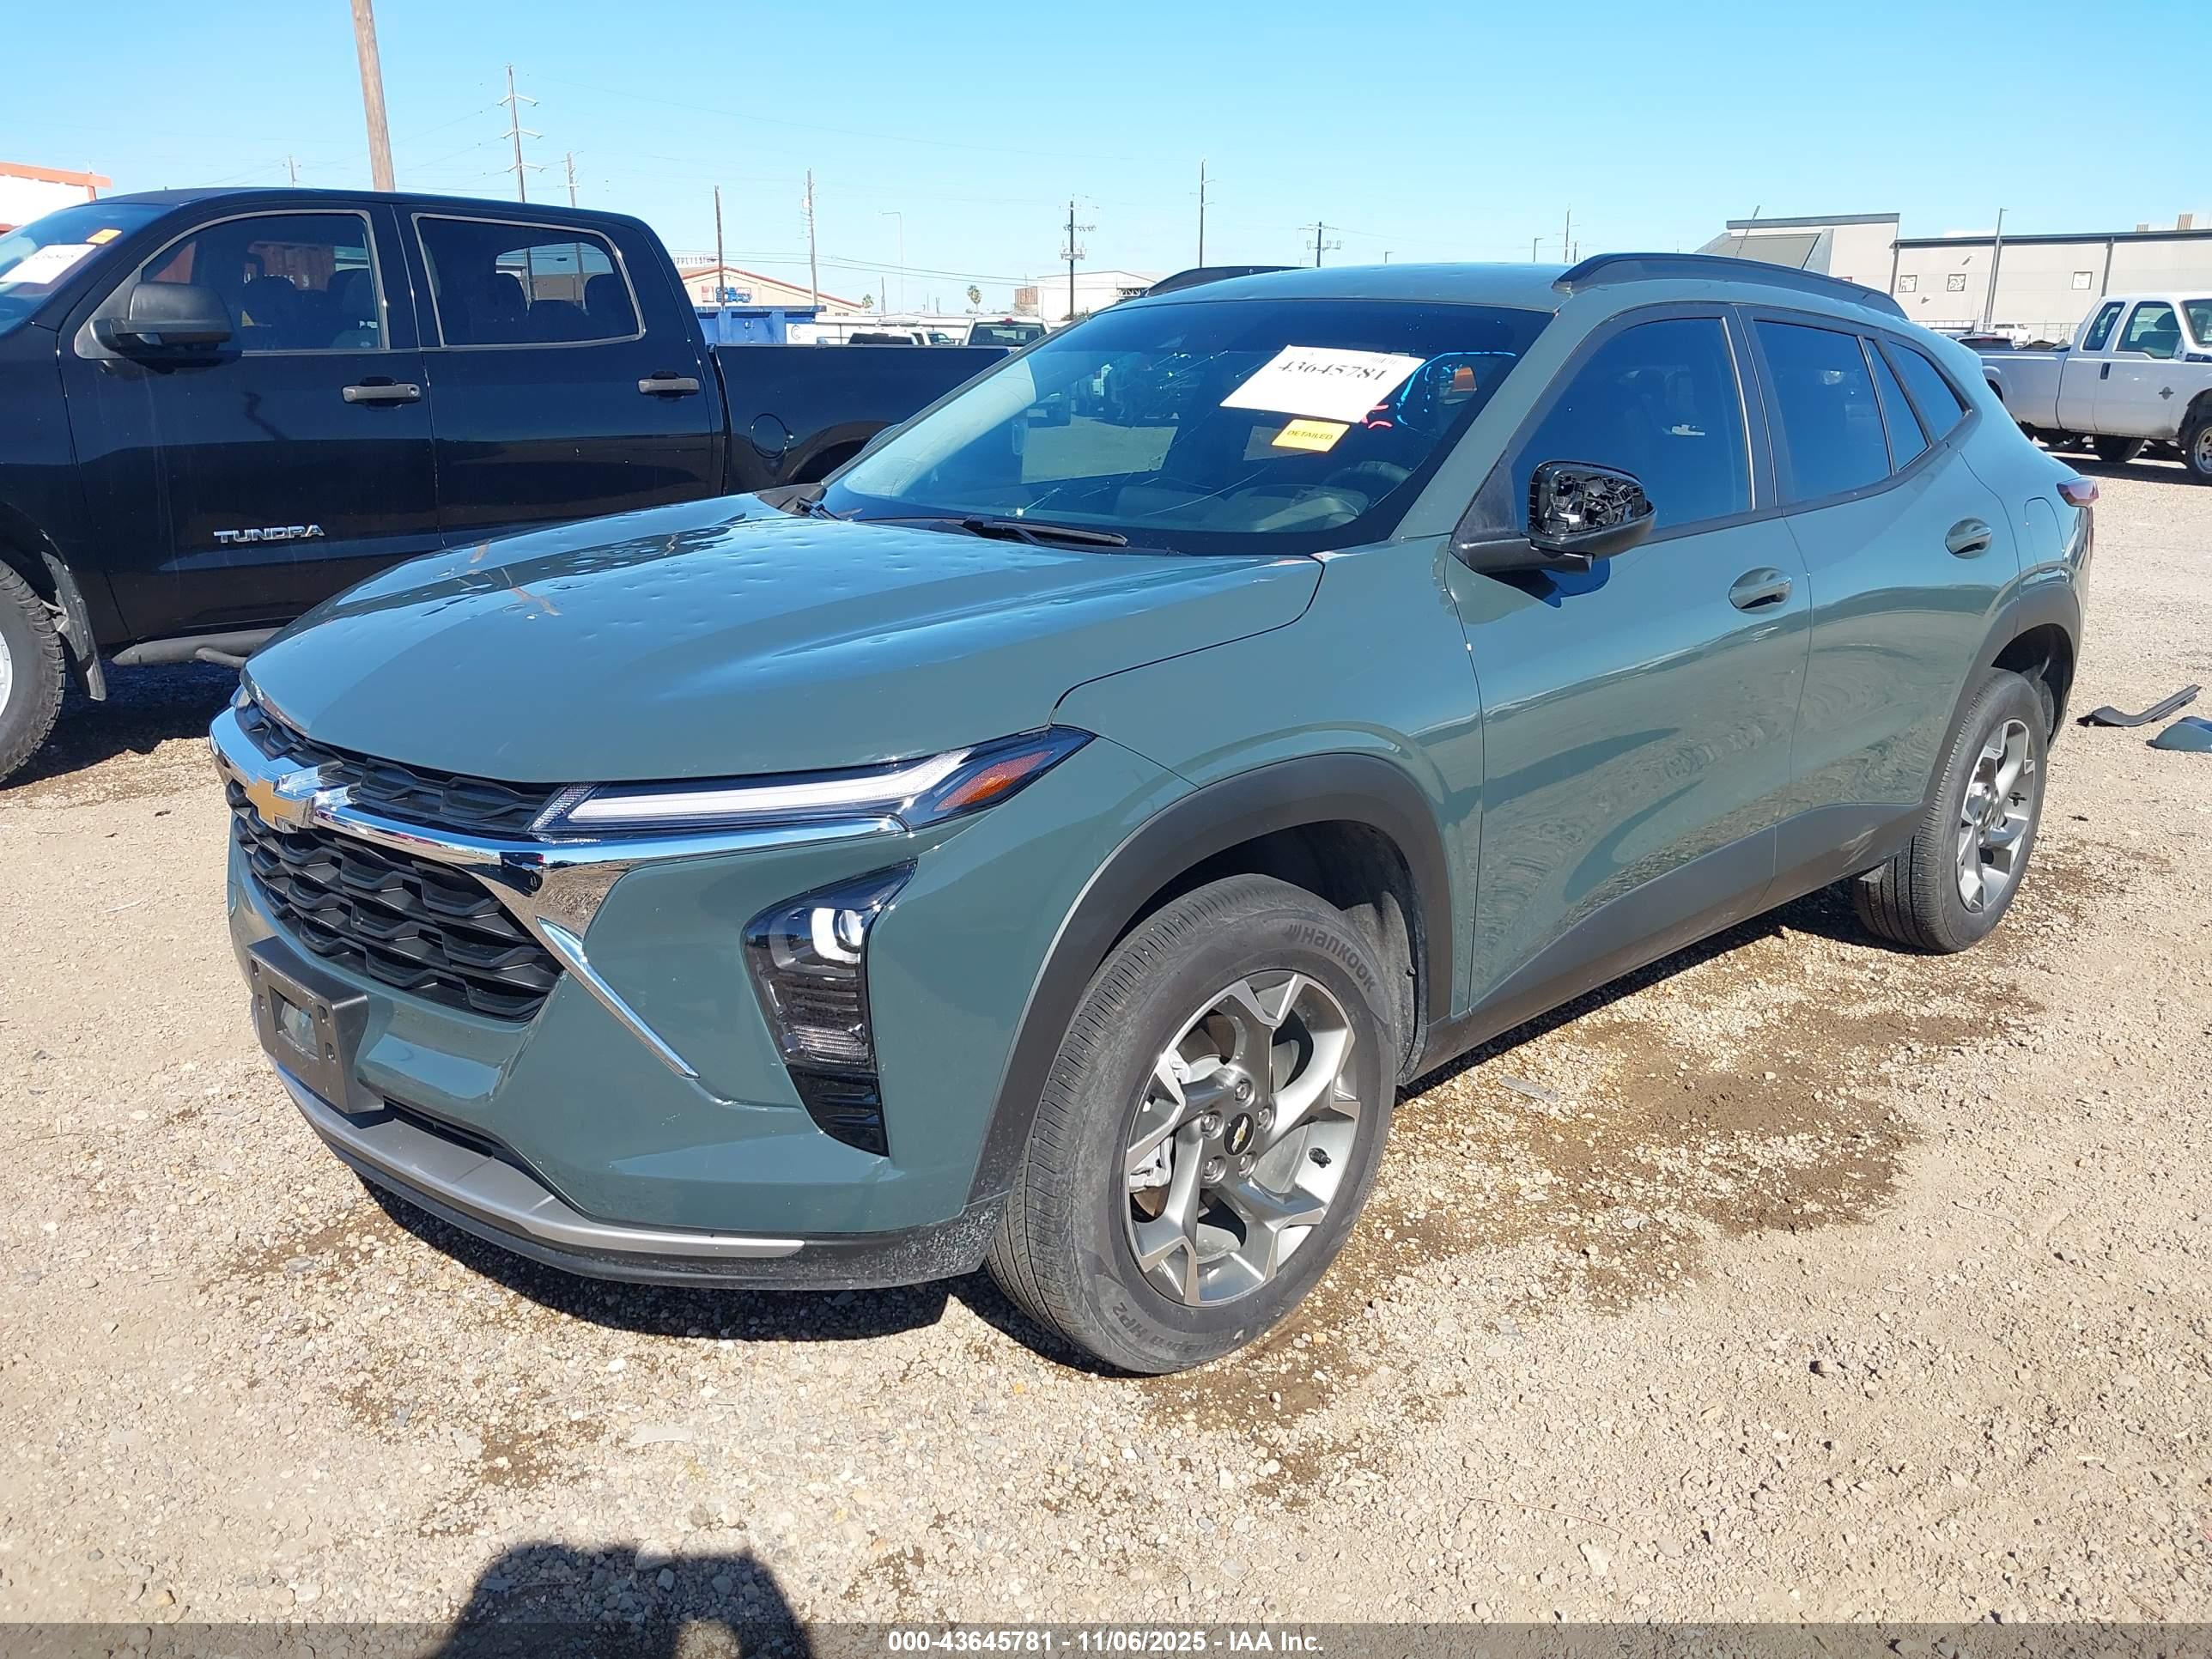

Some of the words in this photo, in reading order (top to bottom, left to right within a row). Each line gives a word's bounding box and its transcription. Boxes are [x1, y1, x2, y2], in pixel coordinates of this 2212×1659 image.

[1279, 360, 1387, 380] 43645781
[1287, 430, 1334, 441] DETAILED
[214, 525, 325, 544] TUNDRA
